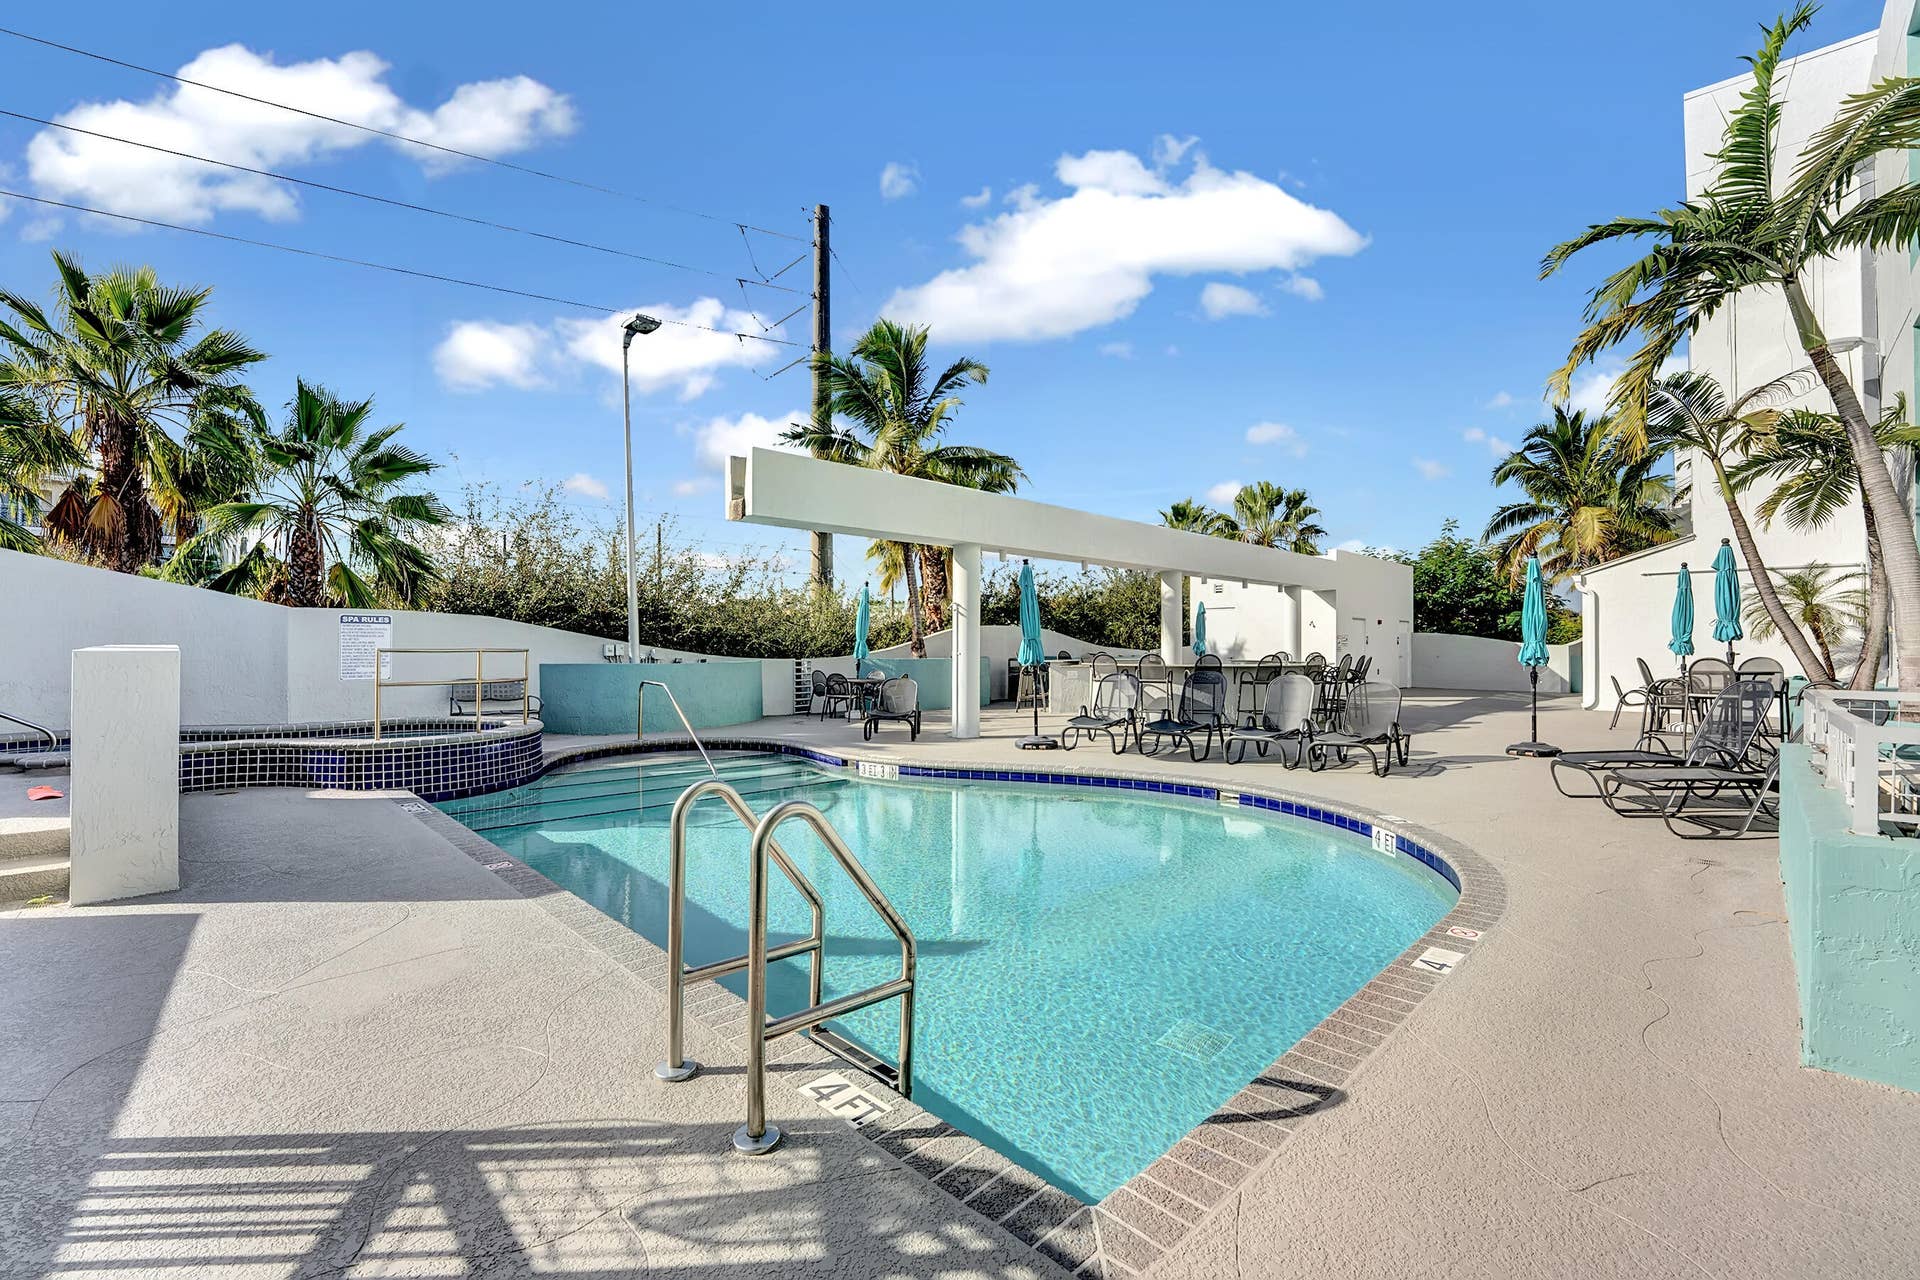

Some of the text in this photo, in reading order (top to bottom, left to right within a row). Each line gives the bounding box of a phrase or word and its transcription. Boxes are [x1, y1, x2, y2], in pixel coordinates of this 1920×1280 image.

[361, 616, 390, 624] RULES
[1419, 958, 1453, 971] 4
[809, 1083, 852, 1103] 4
